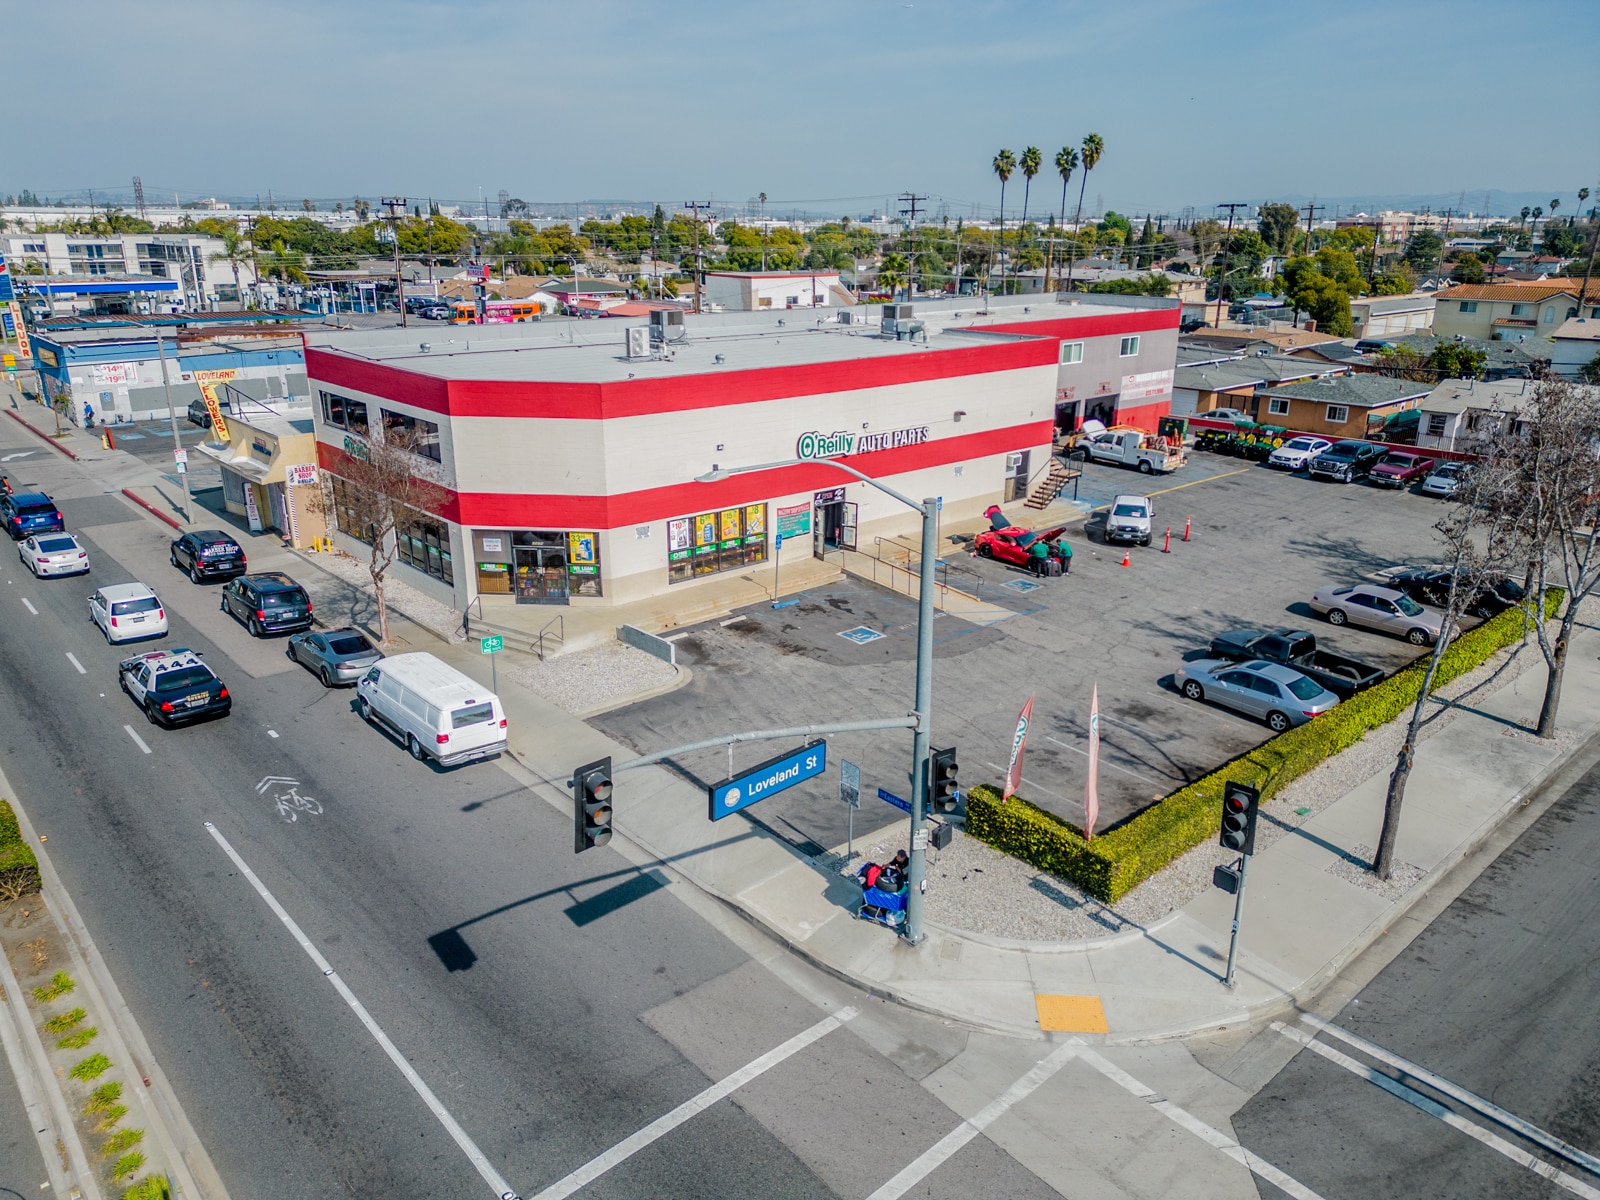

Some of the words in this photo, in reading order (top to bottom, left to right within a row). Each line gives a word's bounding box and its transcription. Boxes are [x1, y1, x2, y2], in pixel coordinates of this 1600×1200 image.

[11, 304, 31, 357] LIQUOR
[197, 370, 235, 380] LOVELAND
[201, 385, 226, 433] FLOWERS
[799, 432, 855, 460] O'Reilly
[858, 433, 890, 454] AUTO
[892, 426, 929, 448] PARTS
[294, 465, 316, 474] BARBER
[298, 471, 312, 480] SHOP
[749, 763, 799, 796] Loveland
[806, 755, 818, 770] St
